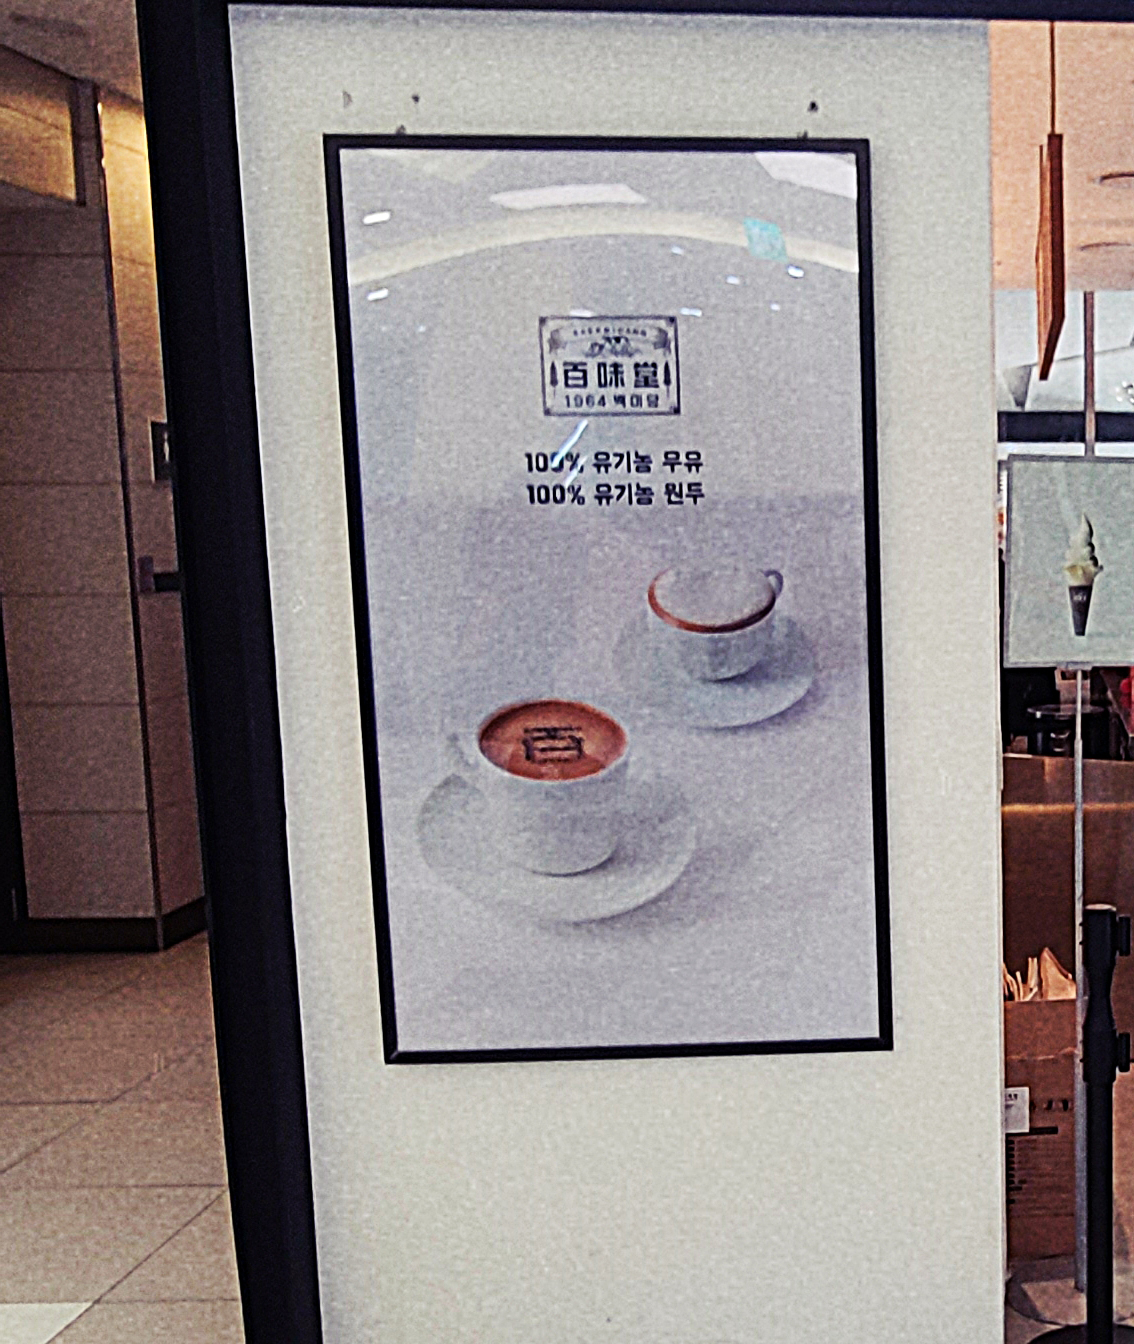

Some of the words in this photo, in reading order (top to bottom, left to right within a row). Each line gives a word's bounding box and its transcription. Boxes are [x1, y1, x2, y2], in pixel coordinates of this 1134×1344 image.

[563, 362, 659, 388] 百味堂
[525, 452, 584, 473] 100%
[592, 451, 653, 474] 유기농
[662, 451, 703, 474] 우유
[526, 484, 586, 505] 100%
[594, 483, 654, 506] 유기농
[664, 482, 705, 506] 원두
